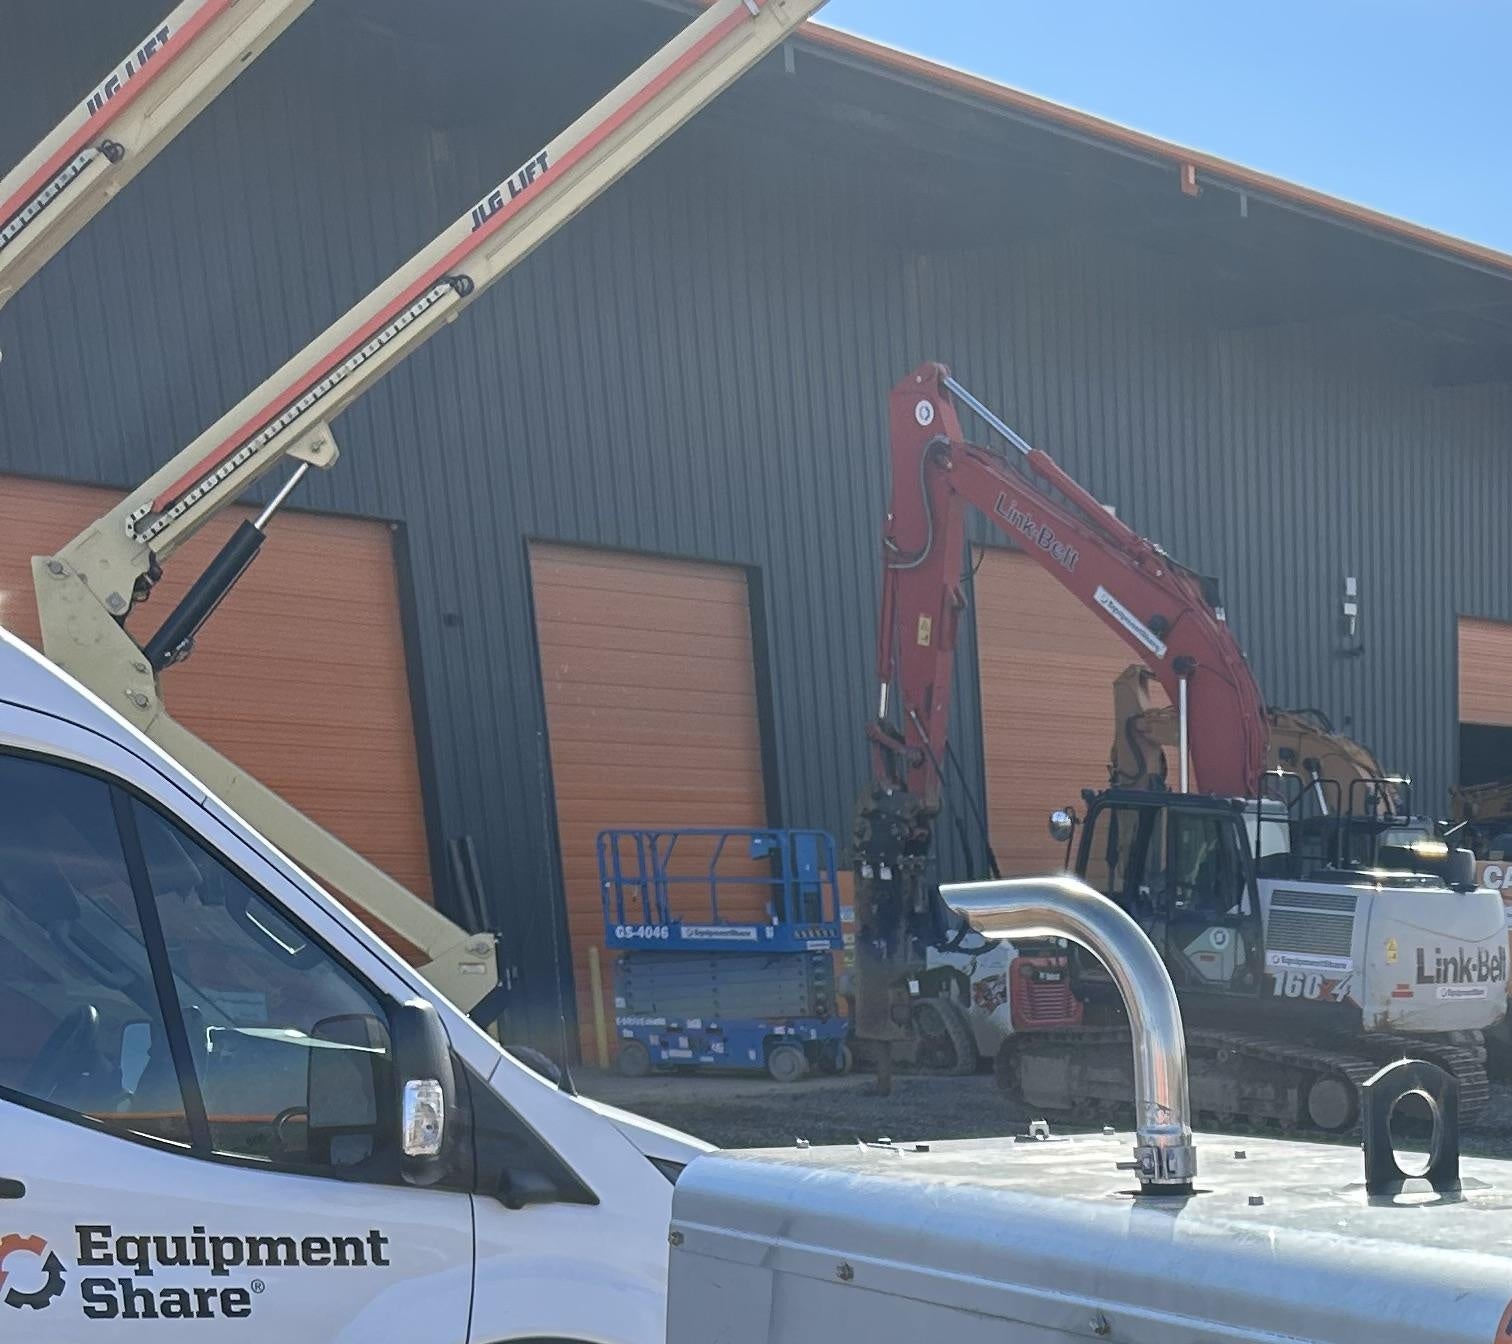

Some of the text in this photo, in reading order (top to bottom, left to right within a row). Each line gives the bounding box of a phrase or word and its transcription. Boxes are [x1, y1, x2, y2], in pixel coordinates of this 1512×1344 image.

[471, 151, 548, 232] JLG LIFT
[615, 925, 669, 940] GS-4046
[75, 1225, 390, 1276] Equipment
